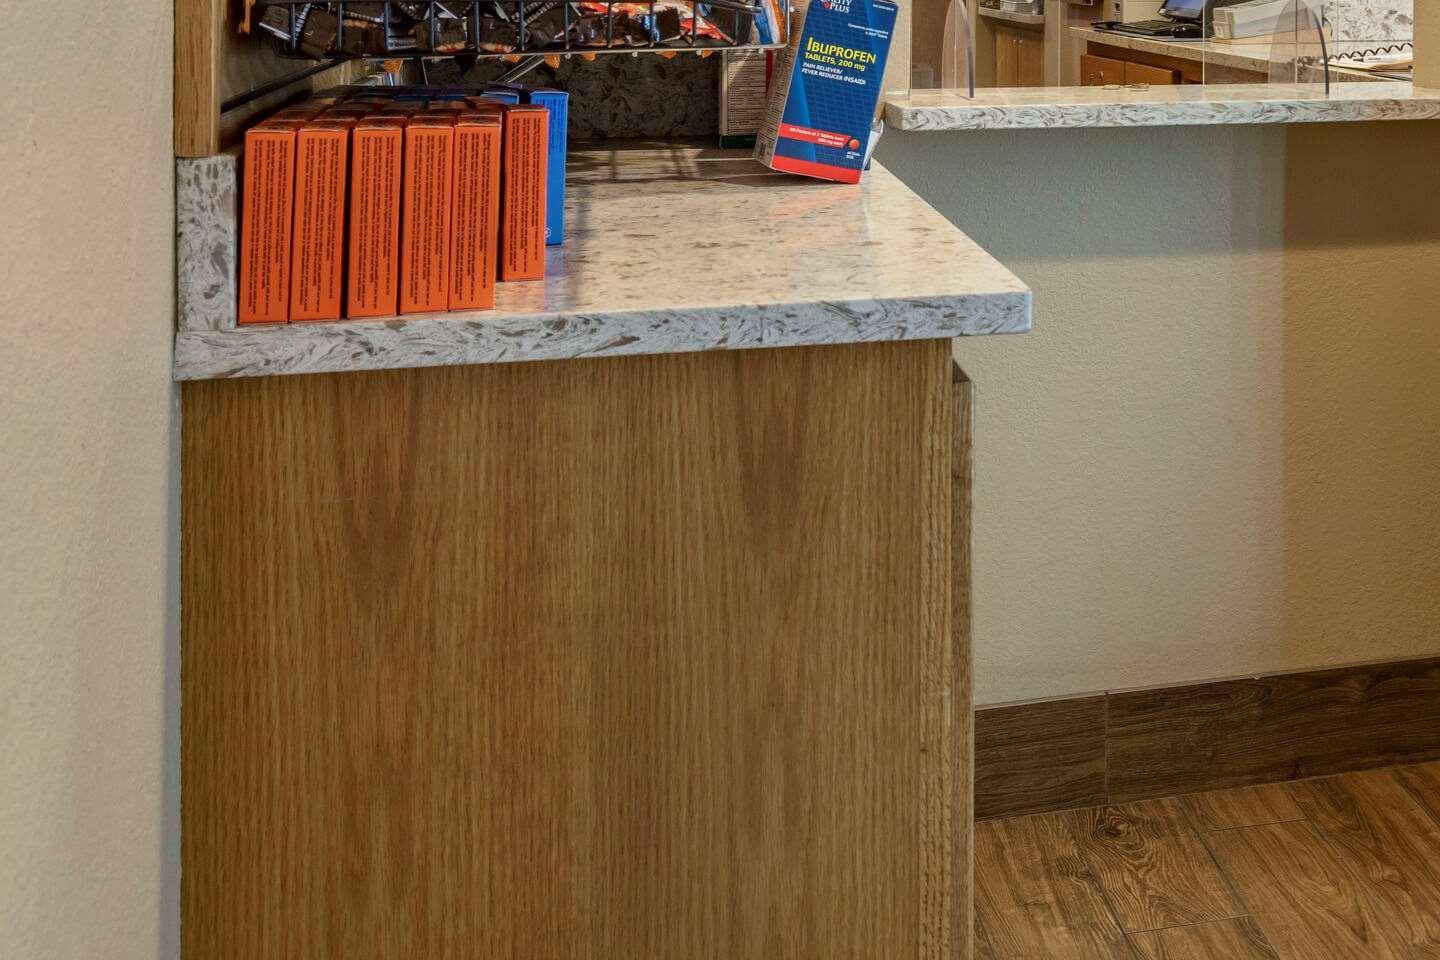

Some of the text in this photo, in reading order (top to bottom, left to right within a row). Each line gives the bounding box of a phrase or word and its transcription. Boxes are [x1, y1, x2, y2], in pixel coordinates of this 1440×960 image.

[829, 1, 851, 14] PLUS
[805, 52, 837, 66] TABLETS,
[838, 59, 853, 69] 200
